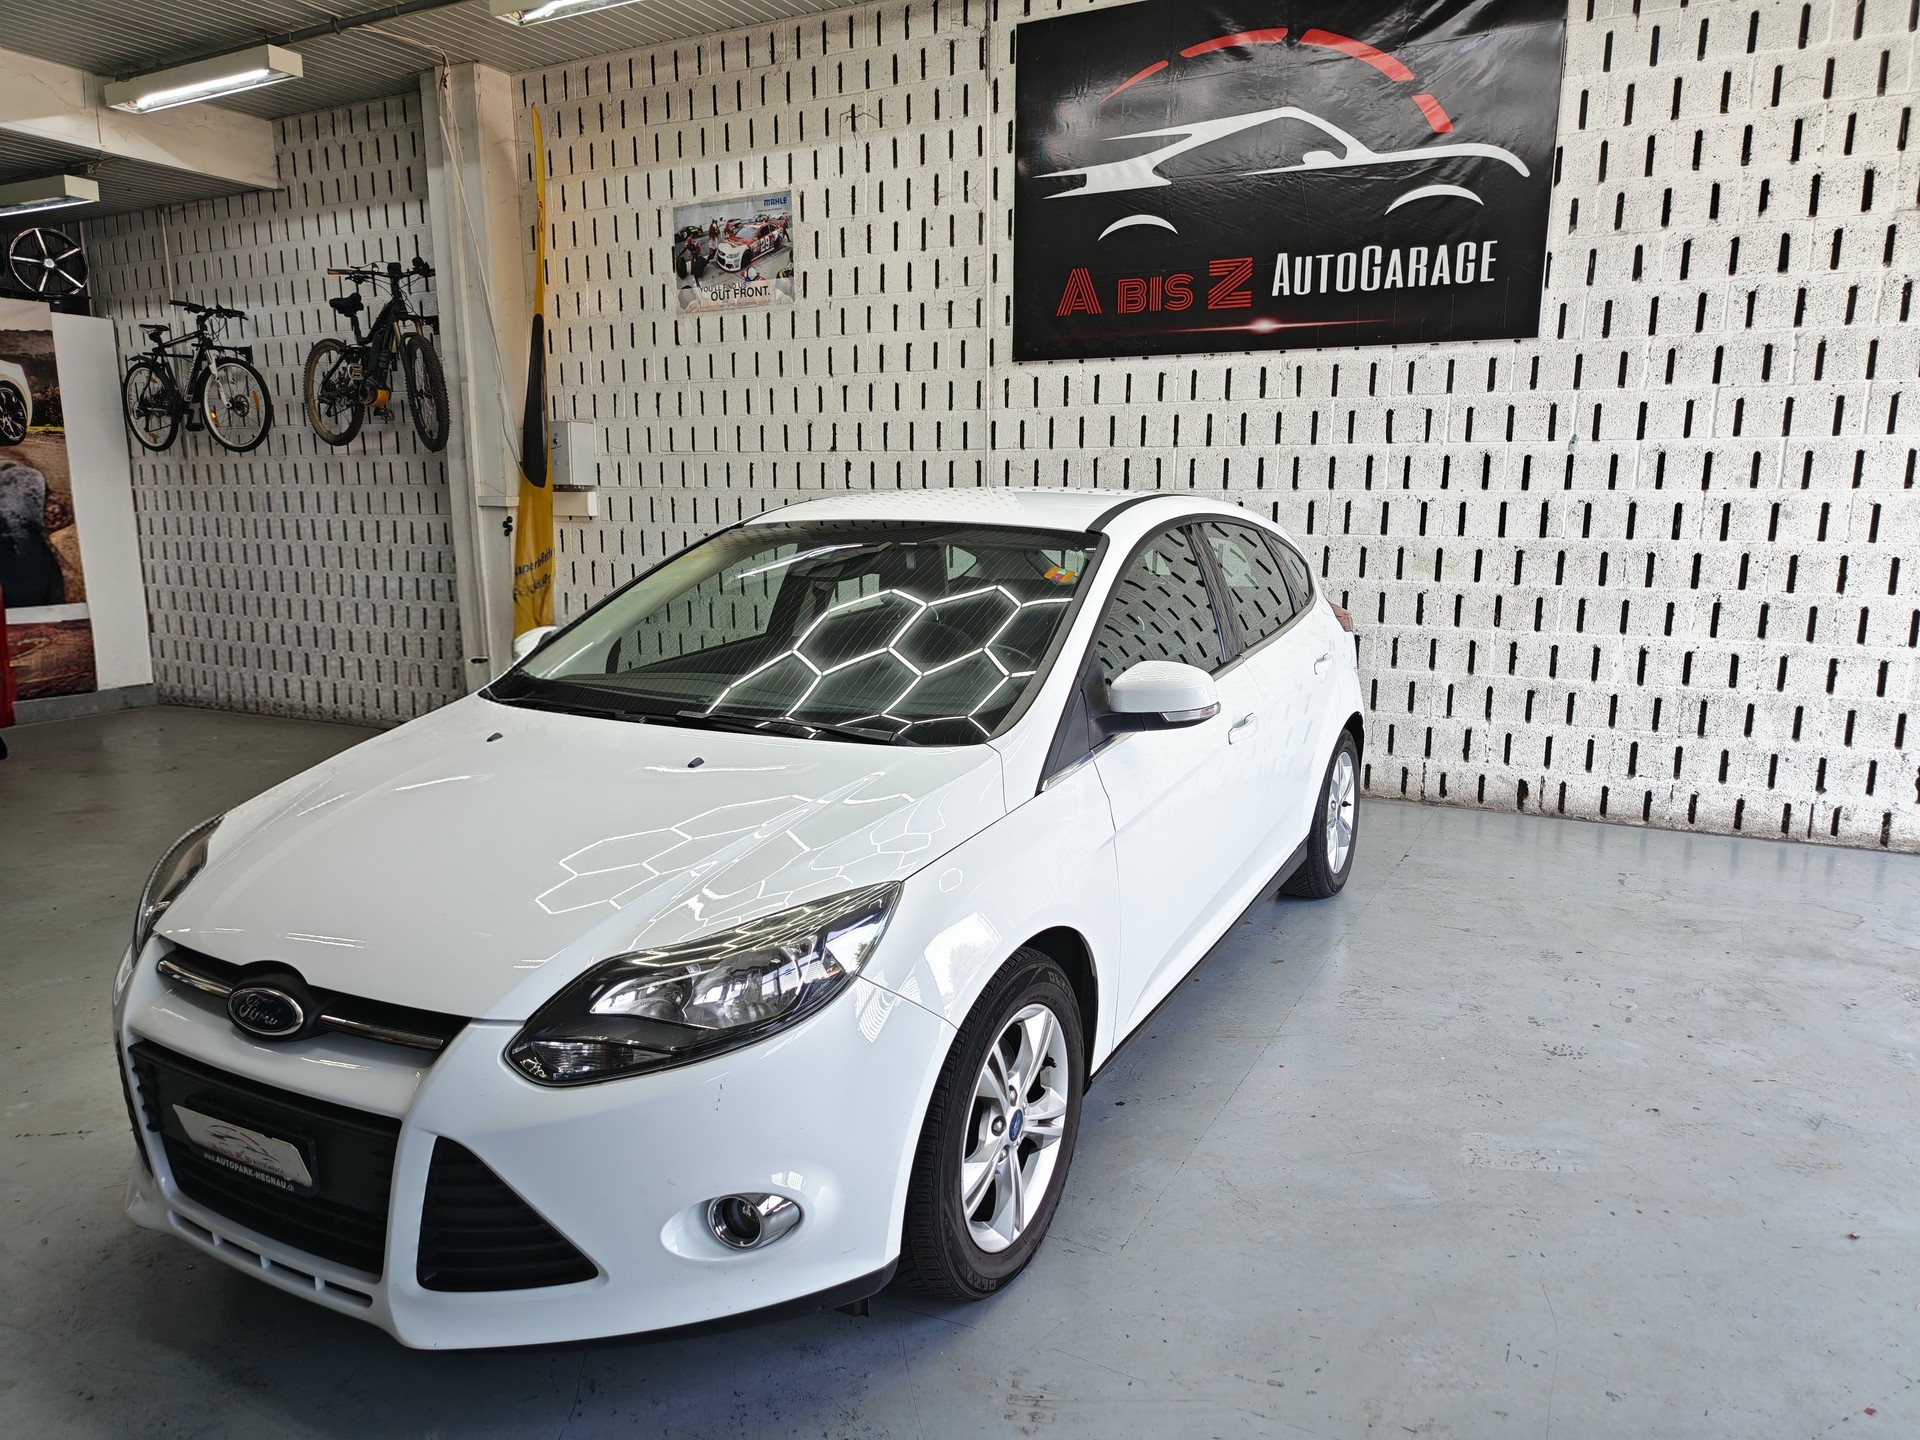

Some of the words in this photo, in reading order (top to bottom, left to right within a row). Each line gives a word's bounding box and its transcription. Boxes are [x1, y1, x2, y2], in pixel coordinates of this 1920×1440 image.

[764, 197, 787, 206] MAHLE
[760, 235, 770, 251] 29
[710, 290, 731, 301] OUT
[734, 285, 771, 299] FRONT.
[738, 281, 747, 289] US
[1056, 267, 1102, 317] A
[1117, 273, 1194, 314] BIS
[1208, 257, 1253, 310] Z
[239, 993, 281, 1025] Ford
